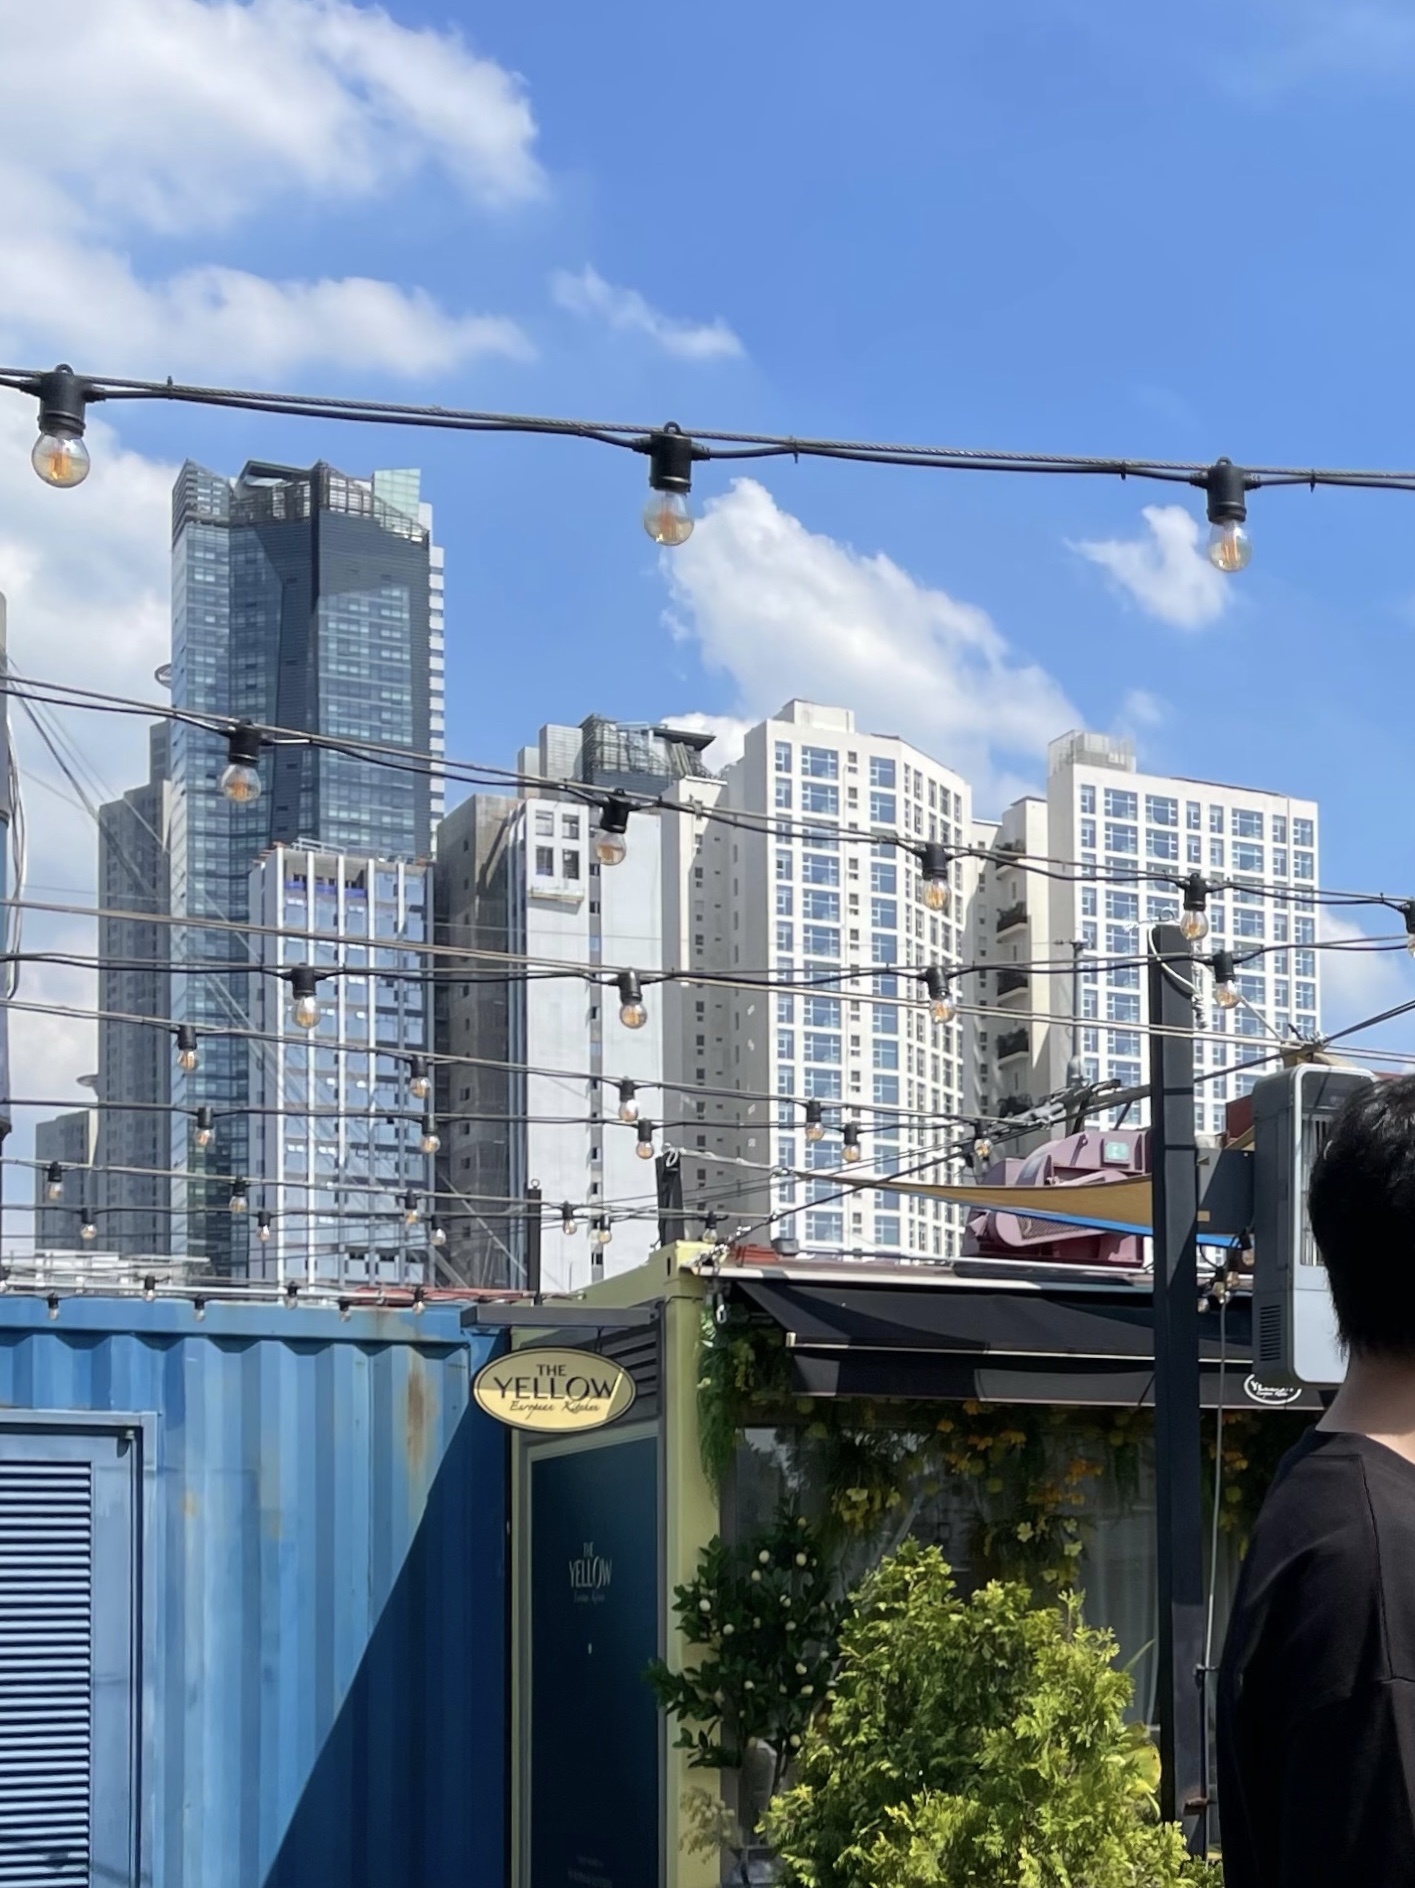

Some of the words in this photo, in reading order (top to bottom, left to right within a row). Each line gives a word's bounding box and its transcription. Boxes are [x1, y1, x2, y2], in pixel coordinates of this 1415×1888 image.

[536, 1364, 567, 1377] THE
[493, 1376, 619, 1401] YELLOW
[509, 1400, 556, 1420] European
[561, 1399, 601, 1414] Kitchen
[568, 1556, 613, 1589] YELLOW
